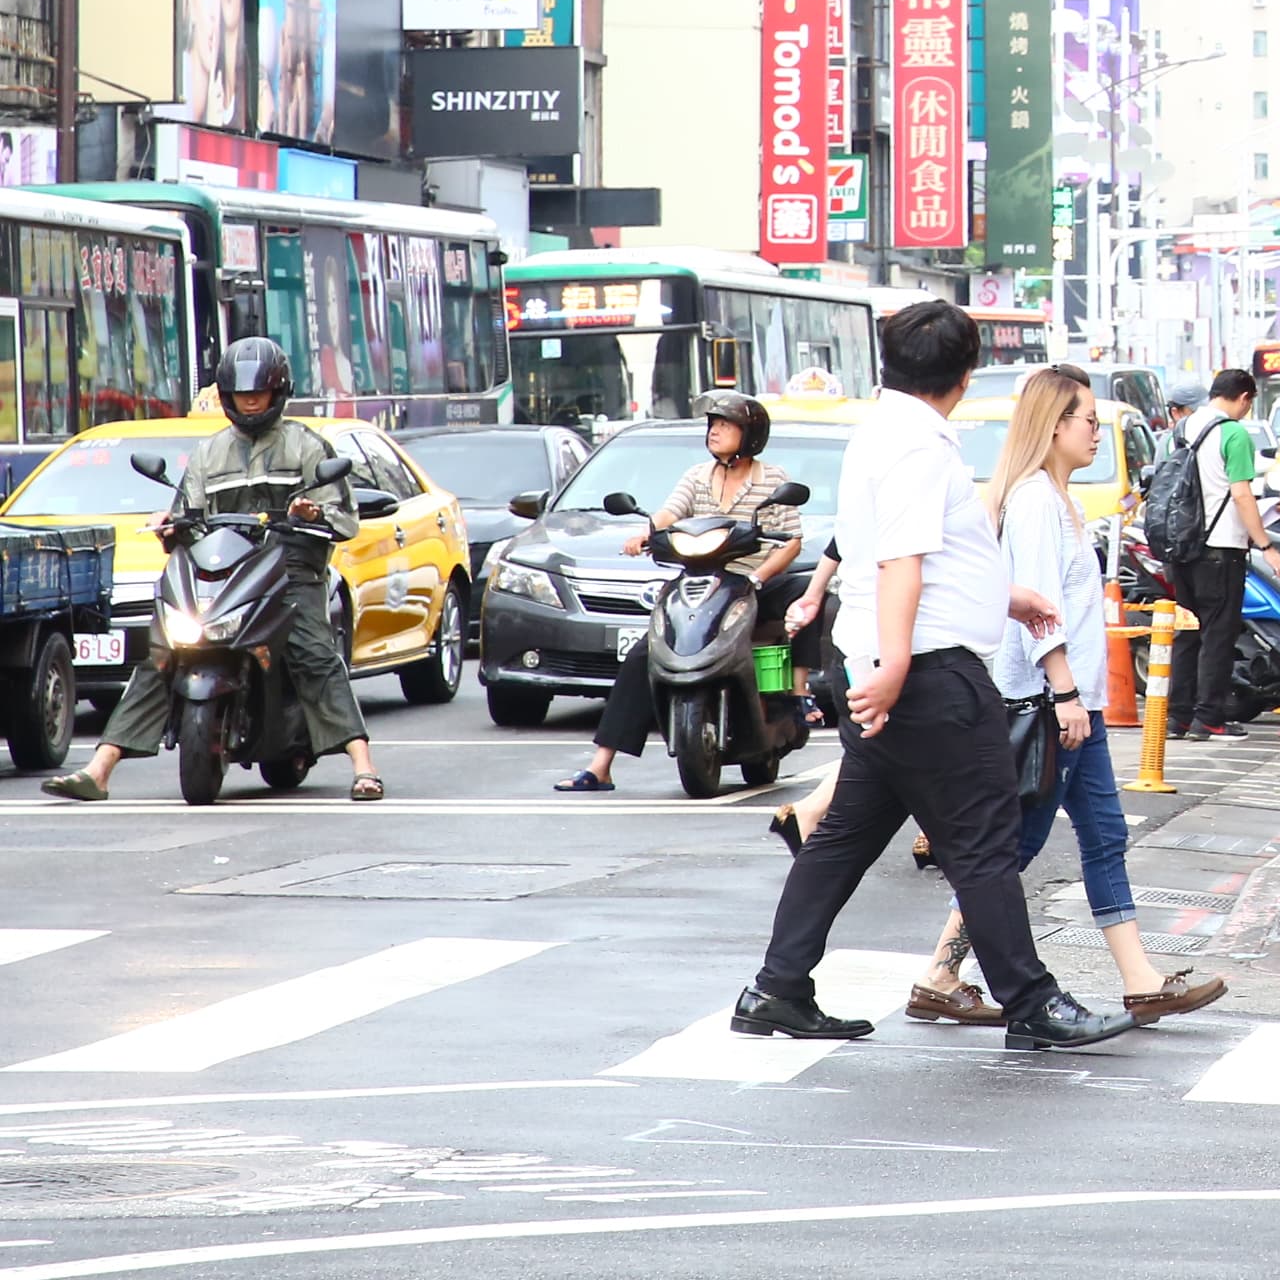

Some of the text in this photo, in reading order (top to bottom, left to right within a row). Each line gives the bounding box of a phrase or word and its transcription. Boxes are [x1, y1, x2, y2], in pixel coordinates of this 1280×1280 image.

[431, 91, 560, 111] SHINZITIY
[773, 24, 815, 185] Tomod's
[908, 88, 949, 228] 休閒食品
